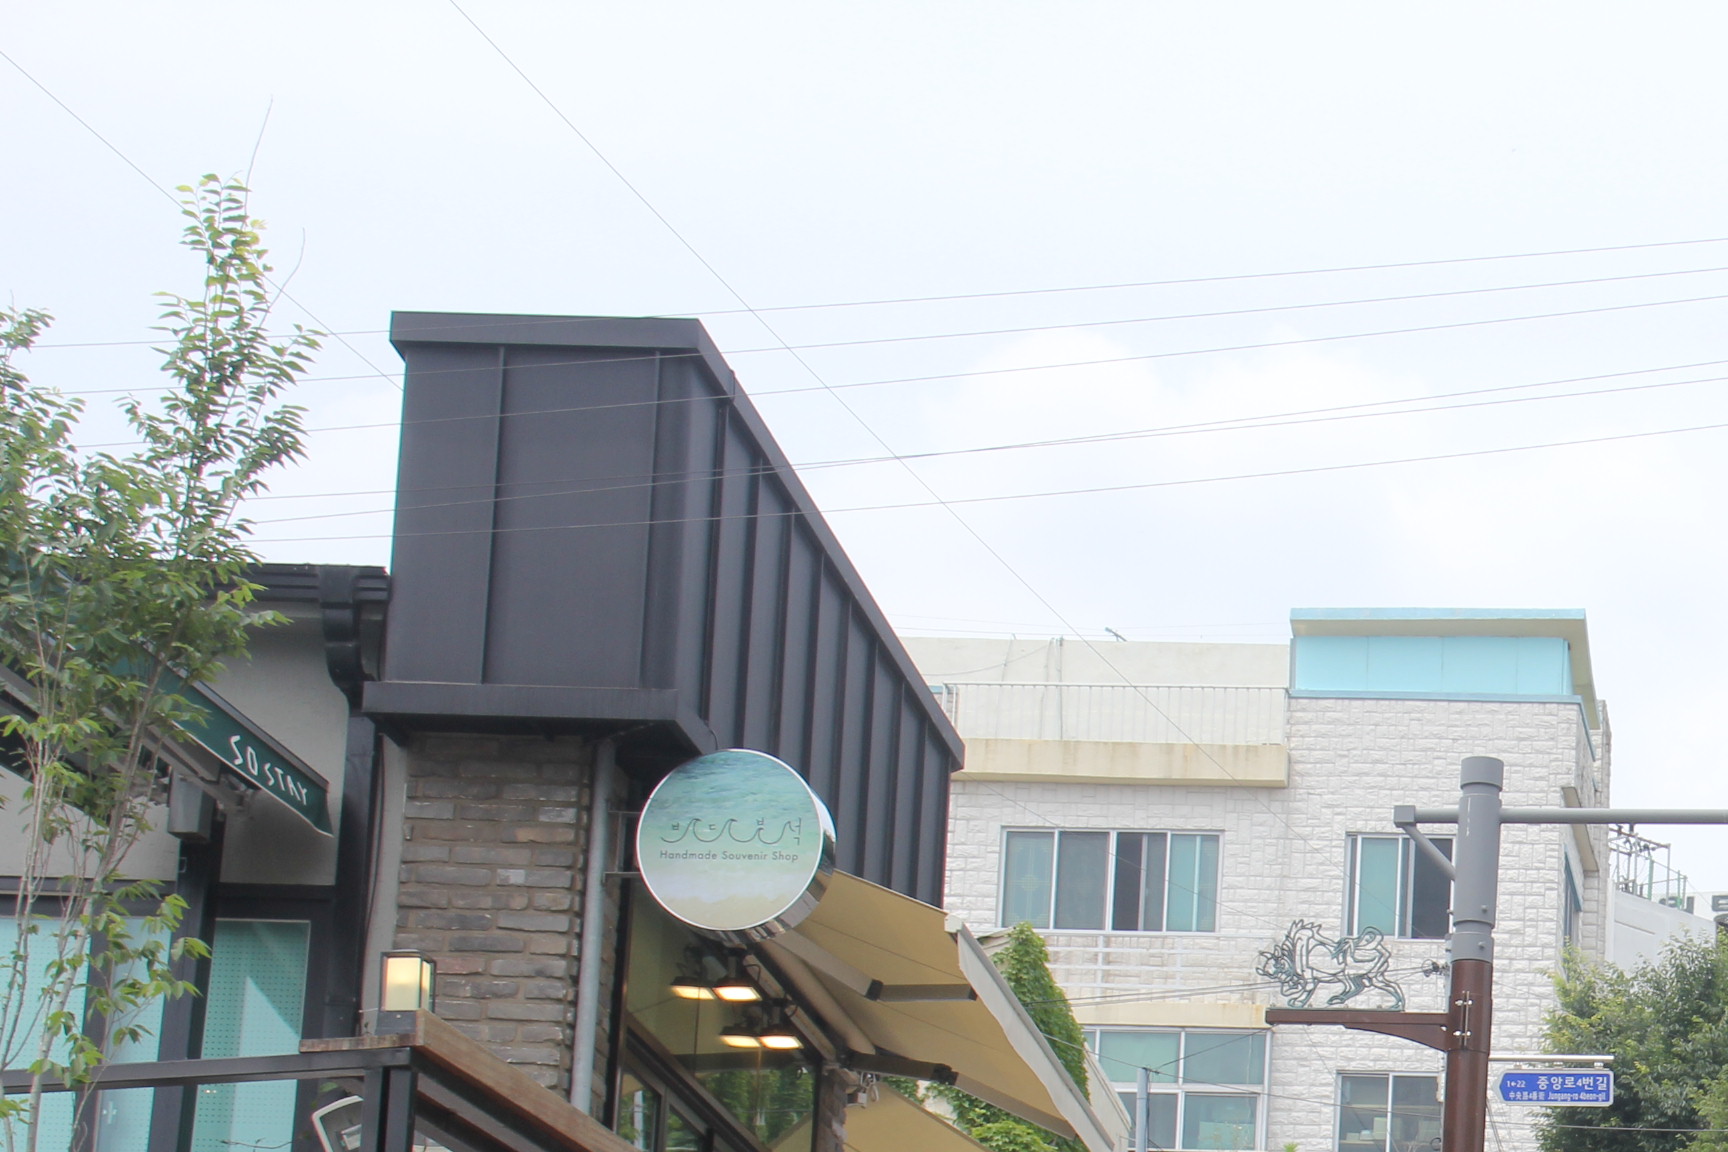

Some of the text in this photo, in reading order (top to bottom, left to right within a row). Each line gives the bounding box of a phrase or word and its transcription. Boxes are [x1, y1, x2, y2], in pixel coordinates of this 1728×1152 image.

[660, 850, 799, 863] Handmade Souvenir Shop
[1537, 1076, 1607, 1091] 중앙로4번길
[1547, 1091, 1579, 1102] Jungang-ro
